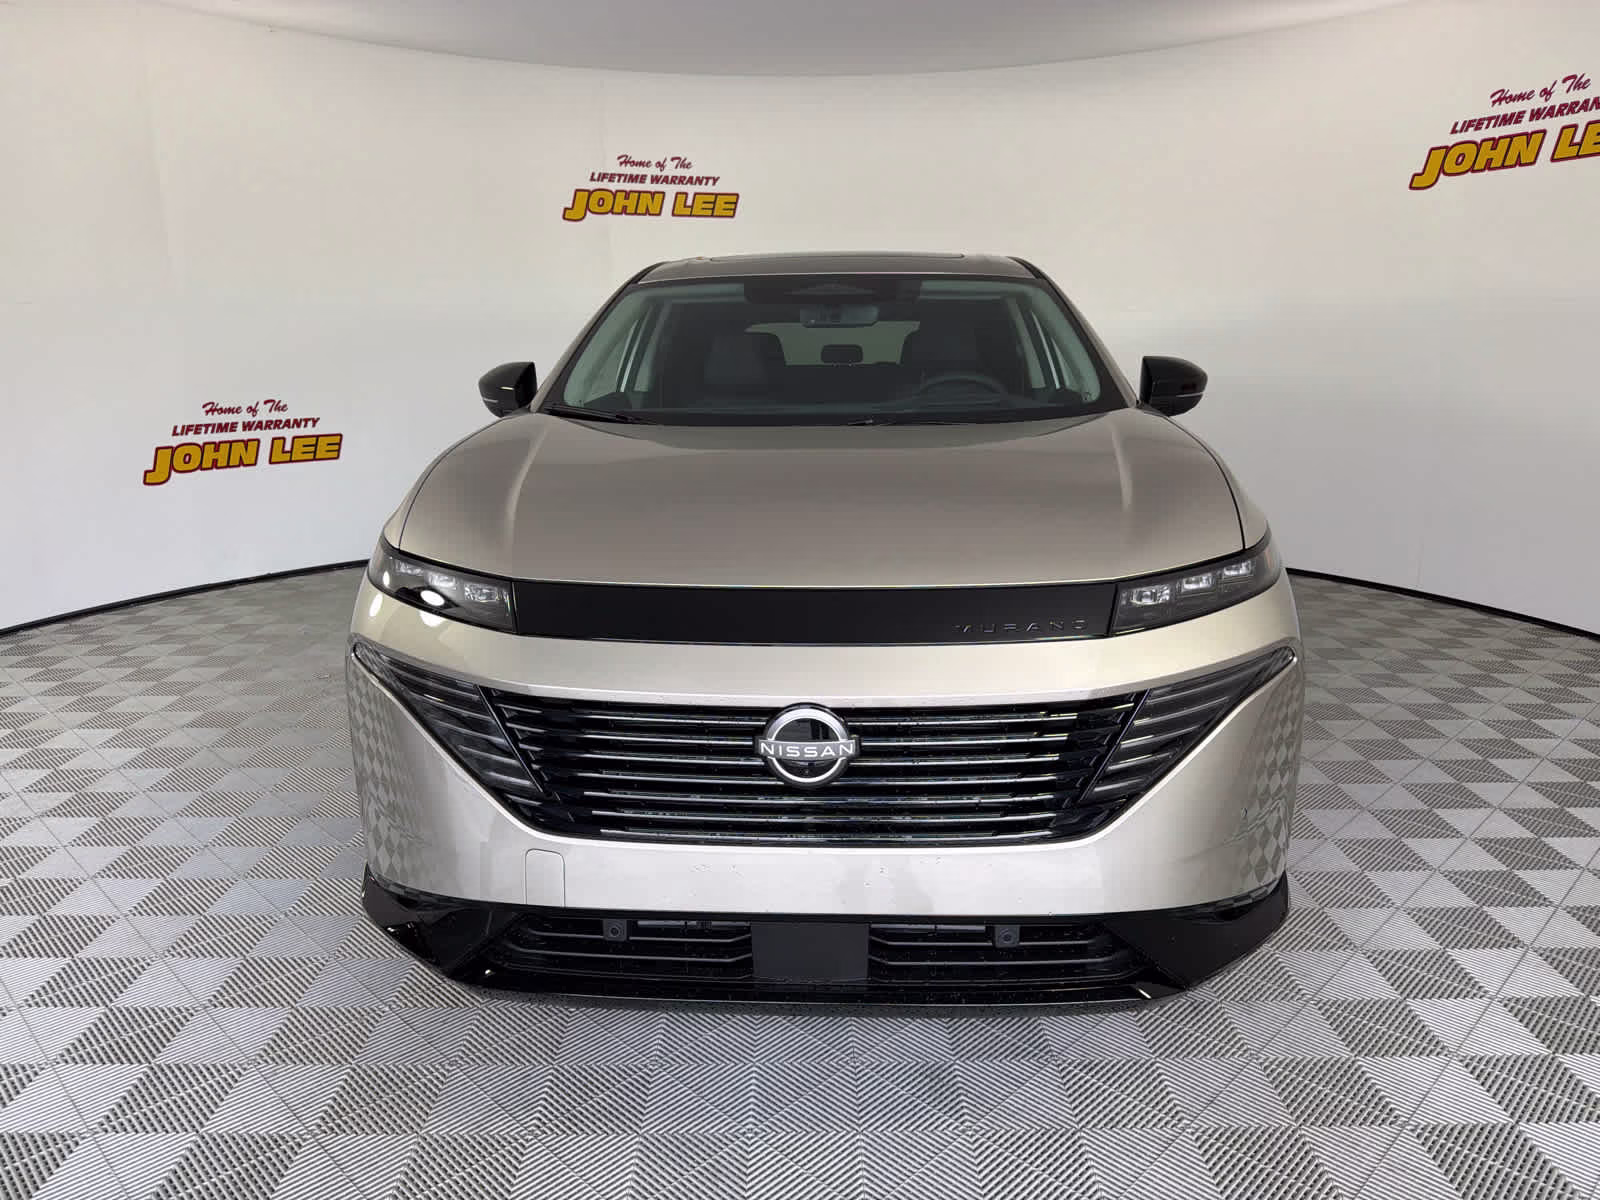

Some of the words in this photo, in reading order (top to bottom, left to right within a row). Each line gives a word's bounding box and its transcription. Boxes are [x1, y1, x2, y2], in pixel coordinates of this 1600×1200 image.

[1490, 89, 1535, 107] Home
[1539, 80, 1558, 102] of
[1562, 73, 1591, 94] The
[1450, 110, 1526, 134] LIFETIME
[617, 154, 652, 169] Home
[655, 157, 667, 172] of
[670, 156, 693, 170] The
[1409, 129, 1547, 190] JOHN
[589, 172, 648, 184] LIFETIME
[650, 174, 720, 186] WARRANTY
[562, 188, 665, 222] JOHN
[672, 191, 739, 218] LEE
[202, 401, 243, 416] Home
[246, 400, 260, 417] of
[263, 399, 288, 413] The
[172, 421, 239, 437] LIFETIME
[241, 417, 320, 432] WARRANTY
[143, 438, 260, 486] JOHN
[269, 433, 343, 465] LEE
[760, 742, 854, 757] NISSAN
